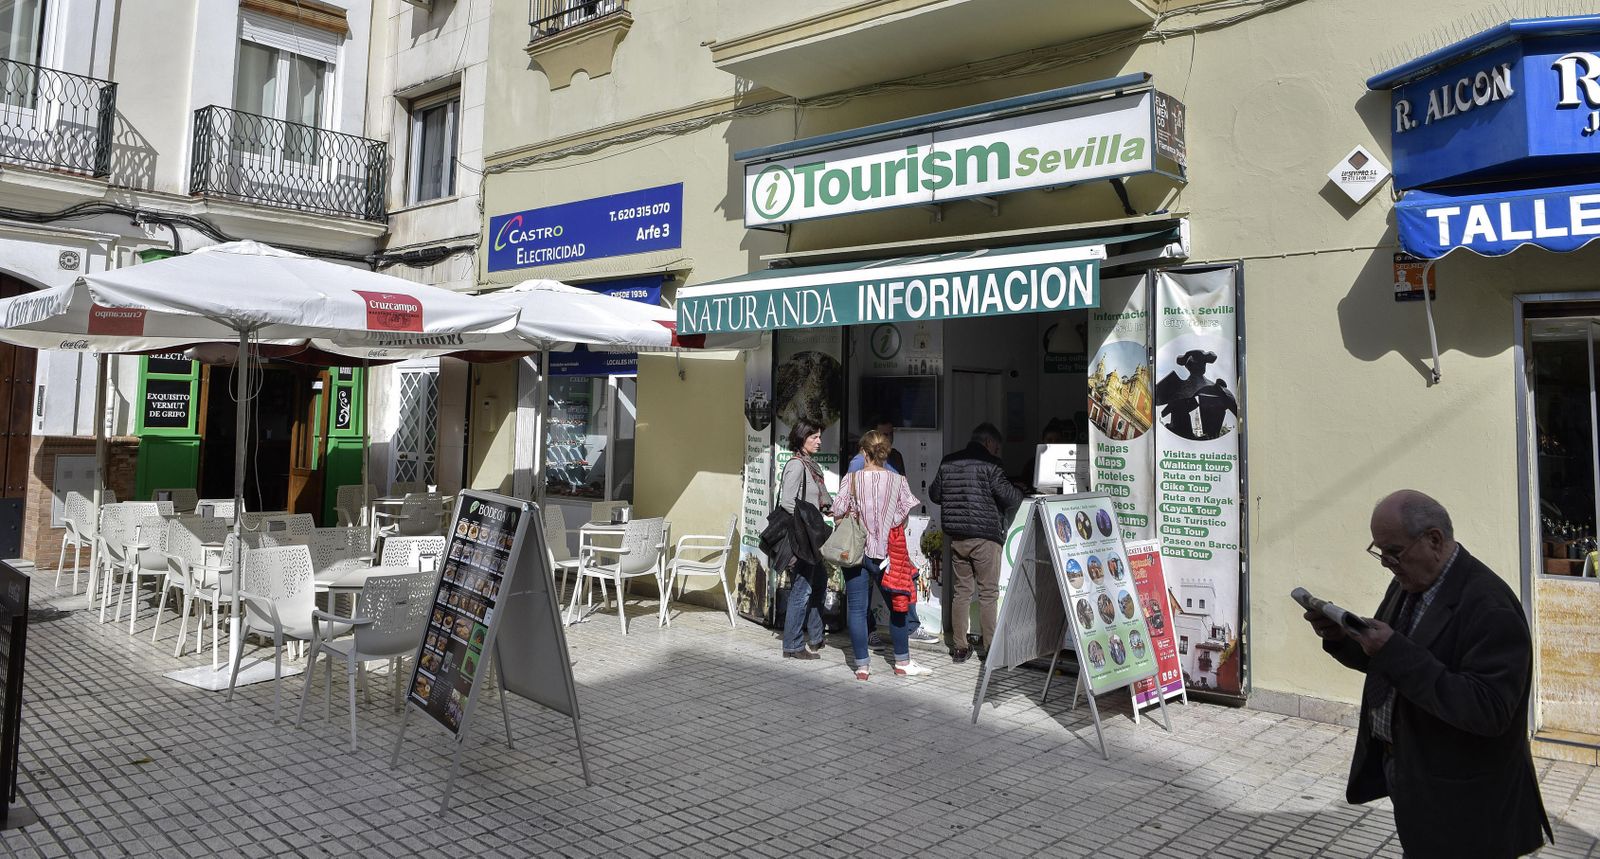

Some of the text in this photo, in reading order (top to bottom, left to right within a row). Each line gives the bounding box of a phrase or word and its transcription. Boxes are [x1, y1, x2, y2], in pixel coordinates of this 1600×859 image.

[1395, 62, 1515, 133] R. ALCON
[794, 140, 1010, 208] Tourism
[1015, 134, 1145, 178] Sevilla
[609, 202, 670, 222] T. 620 315 070
[508, 225, 563, 244] CASTRO
[636, 223, 670, 241] Arfe 3
[516, 244, 586, 265] ELECTRICIDAD
[631, 290, 648, 298] 1936
[681, 263, 1094, 334] NATURANDA INFORMACION
[370, 300, 418, 313] Cruzcampo
[1198, 306, 1234, 316] Sevilla
[1163, 318, 1185, 330] City
[60, 340, 89, 349] Coca-Cola
[606, 358, 628, 366] LOCALES
[147, 392, 190, 400] EXQUISITO
[152, 402, 184, 410] VERMUT
[162, 410, 186, 418] GRIFO
[1097, 443, 1128, 454] Mapas
[1163, 450, 1237, 461] Visitas guiadas
[1097, 457, 1122, 468] Maps
[1163, 461, 1230, 471] Walking tours
[1097, 471, 1134, 482] Hoteles
[1163, 472, 1186, 480] Ruta
[1204, 474, 1221, 482] bici
[1097, 485, 1128, 496] Hotels
[1163, 482, 1210, 492] Bike Tour
[1163, 494, 1186, 502] Ruta
[1204, 496, 1233, 506] Kayak
[1163, 504, 1217, 514] Kayak Tour
[1163, 515, 1226, 527] Bus Turístico
[1163, 526, 1205, 536] Bus Tour
[1163, 537, 1192, 546] Paseo
[1209, 541, 1237, 550] Barco
[1163, 547, 1210, 559] Boat Tour
